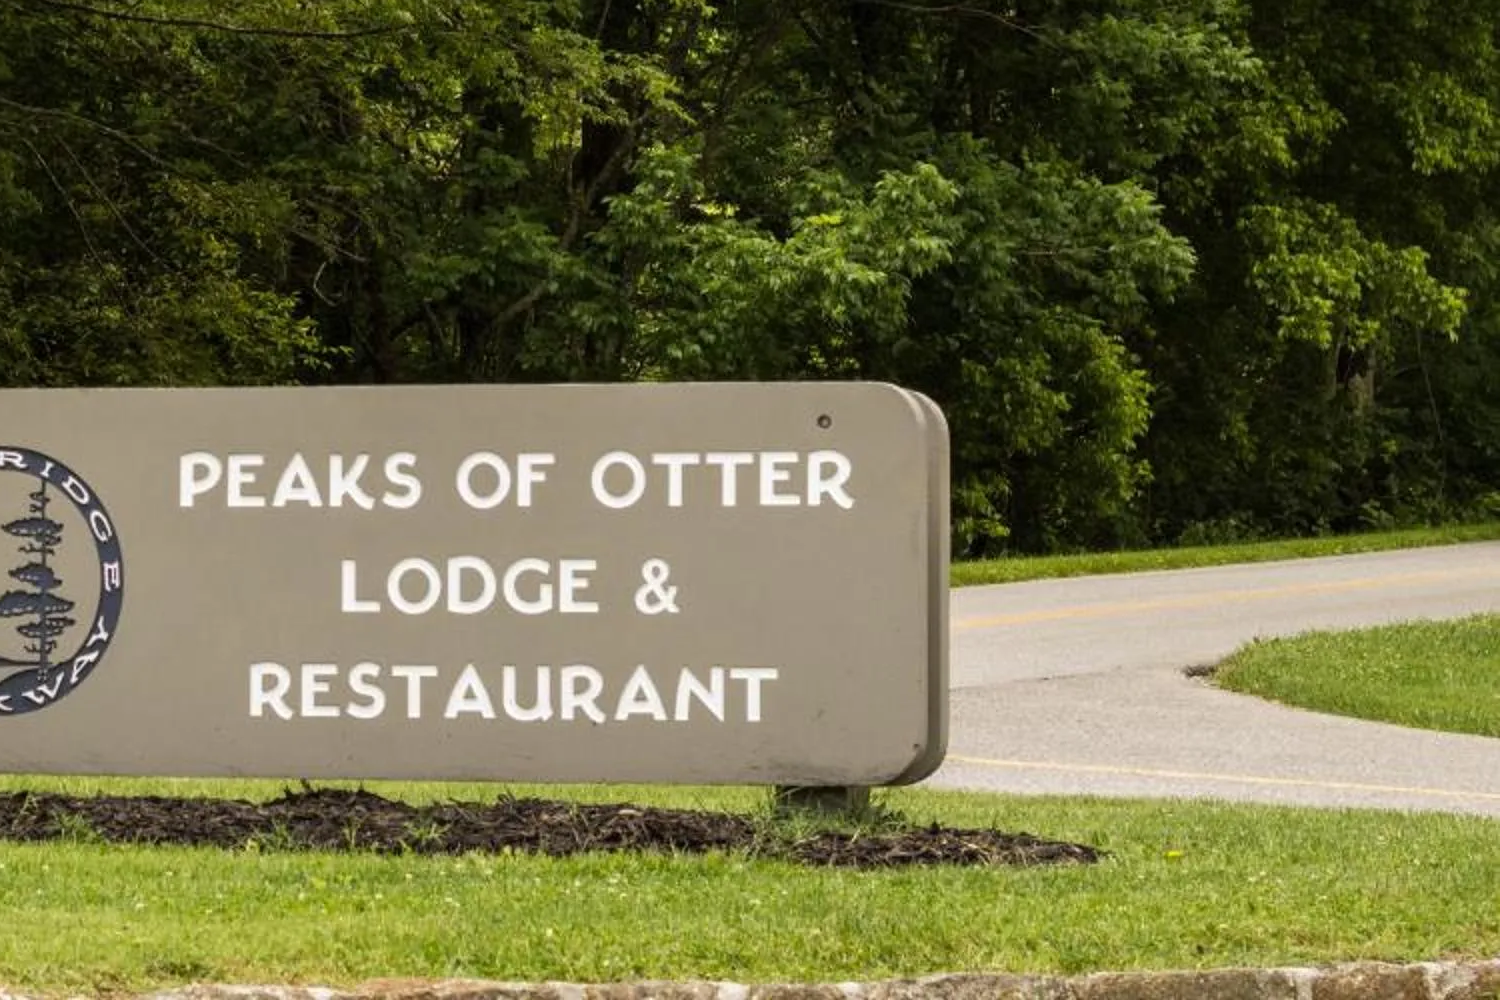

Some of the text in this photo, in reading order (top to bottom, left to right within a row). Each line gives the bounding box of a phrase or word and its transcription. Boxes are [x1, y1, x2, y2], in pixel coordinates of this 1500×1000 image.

[179, 450, 855, 510] PEAKS OF OTTER
[341, 556, 680, 615] LODGE &
[249, 662, 779, 724] RESTAURANT
